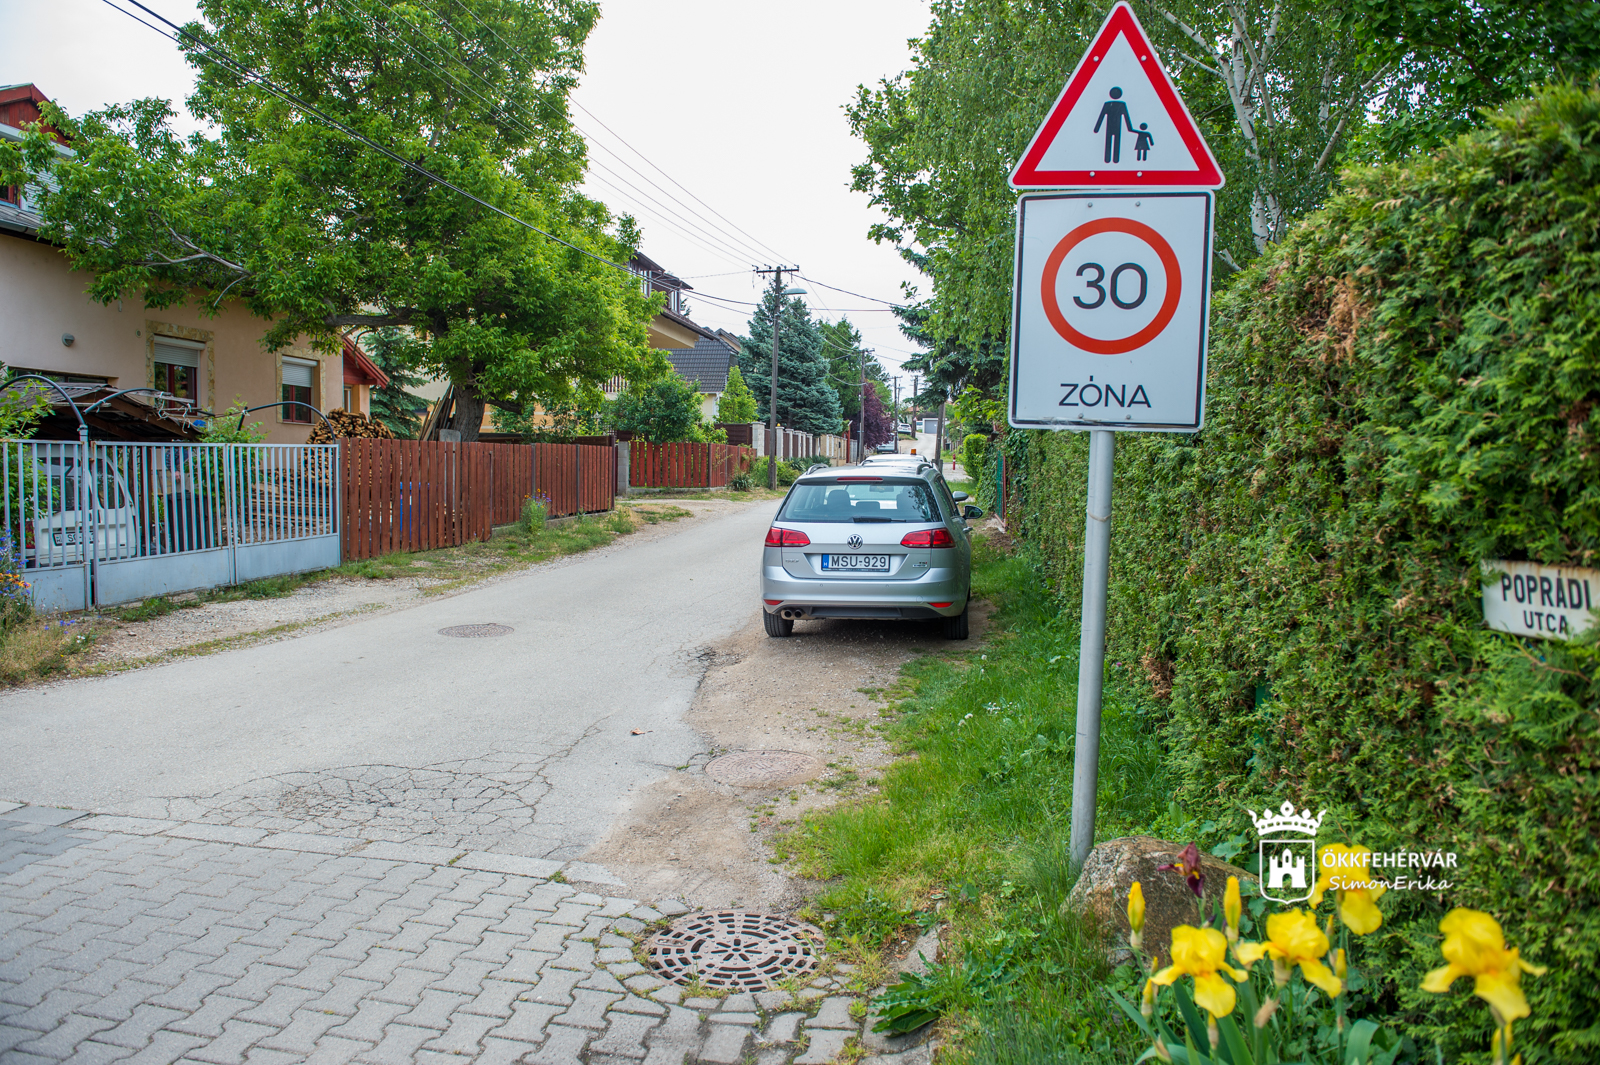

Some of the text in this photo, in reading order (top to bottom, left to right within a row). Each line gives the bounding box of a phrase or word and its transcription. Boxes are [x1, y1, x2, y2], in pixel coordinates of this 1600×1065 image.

[1073, 262, 1148, 310] 30
[1058, 375, 1152, 408] ZÓNA
[831, 555, 887, 567] MSU-929
[1501, 569, 1592, 610] POPRÁDI
[1523, 610, 1569, 634] UTCA
